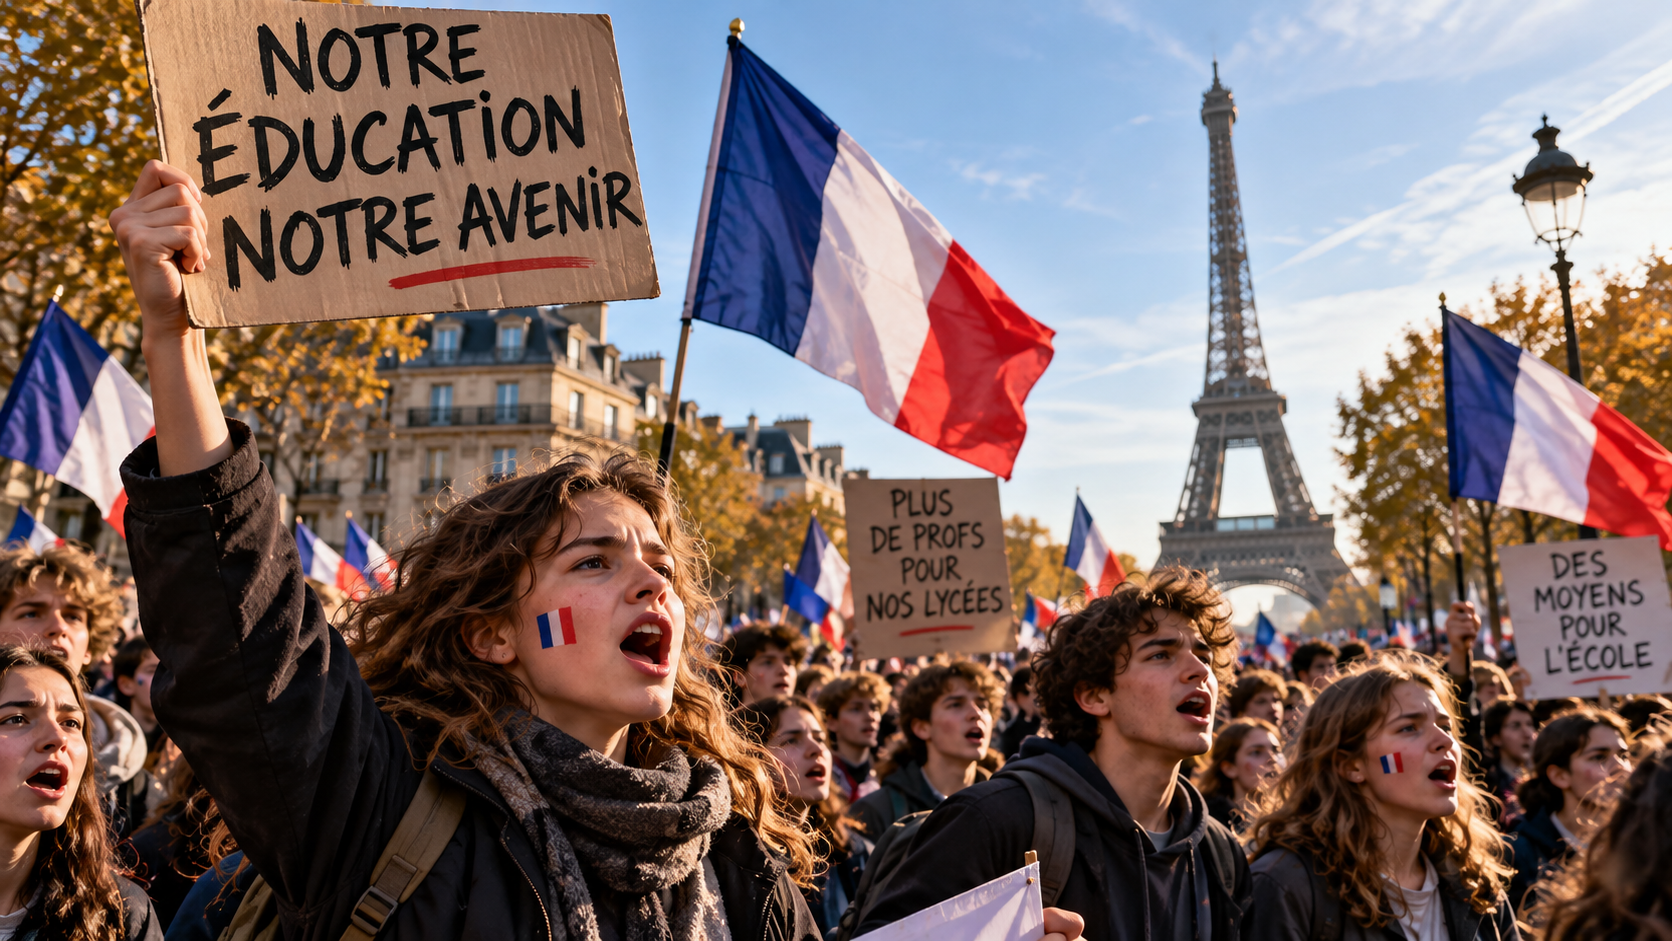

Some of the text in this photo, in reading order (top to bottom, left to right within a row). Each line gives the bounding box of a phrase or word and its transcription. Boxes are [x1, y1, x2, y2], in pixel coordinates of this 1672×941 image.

[257, 17, 486, 99] NOTRE
[222, 192, 441, 292] NOTRE
[890, 488, 953, 519] PLUS
[869, 522, 985, 554] DE PROFS
[901, 555, 962, 585] POUR
[1550, 550, 1607, 580] DES
[866, 579, 1003, 622] NOS LYCÉES
[1534, 579, 1645, 612] MOYENS
[1559, 611, 1627, 640] POUR
[1544, 639, 1653, 675] L'ÉCOLE
